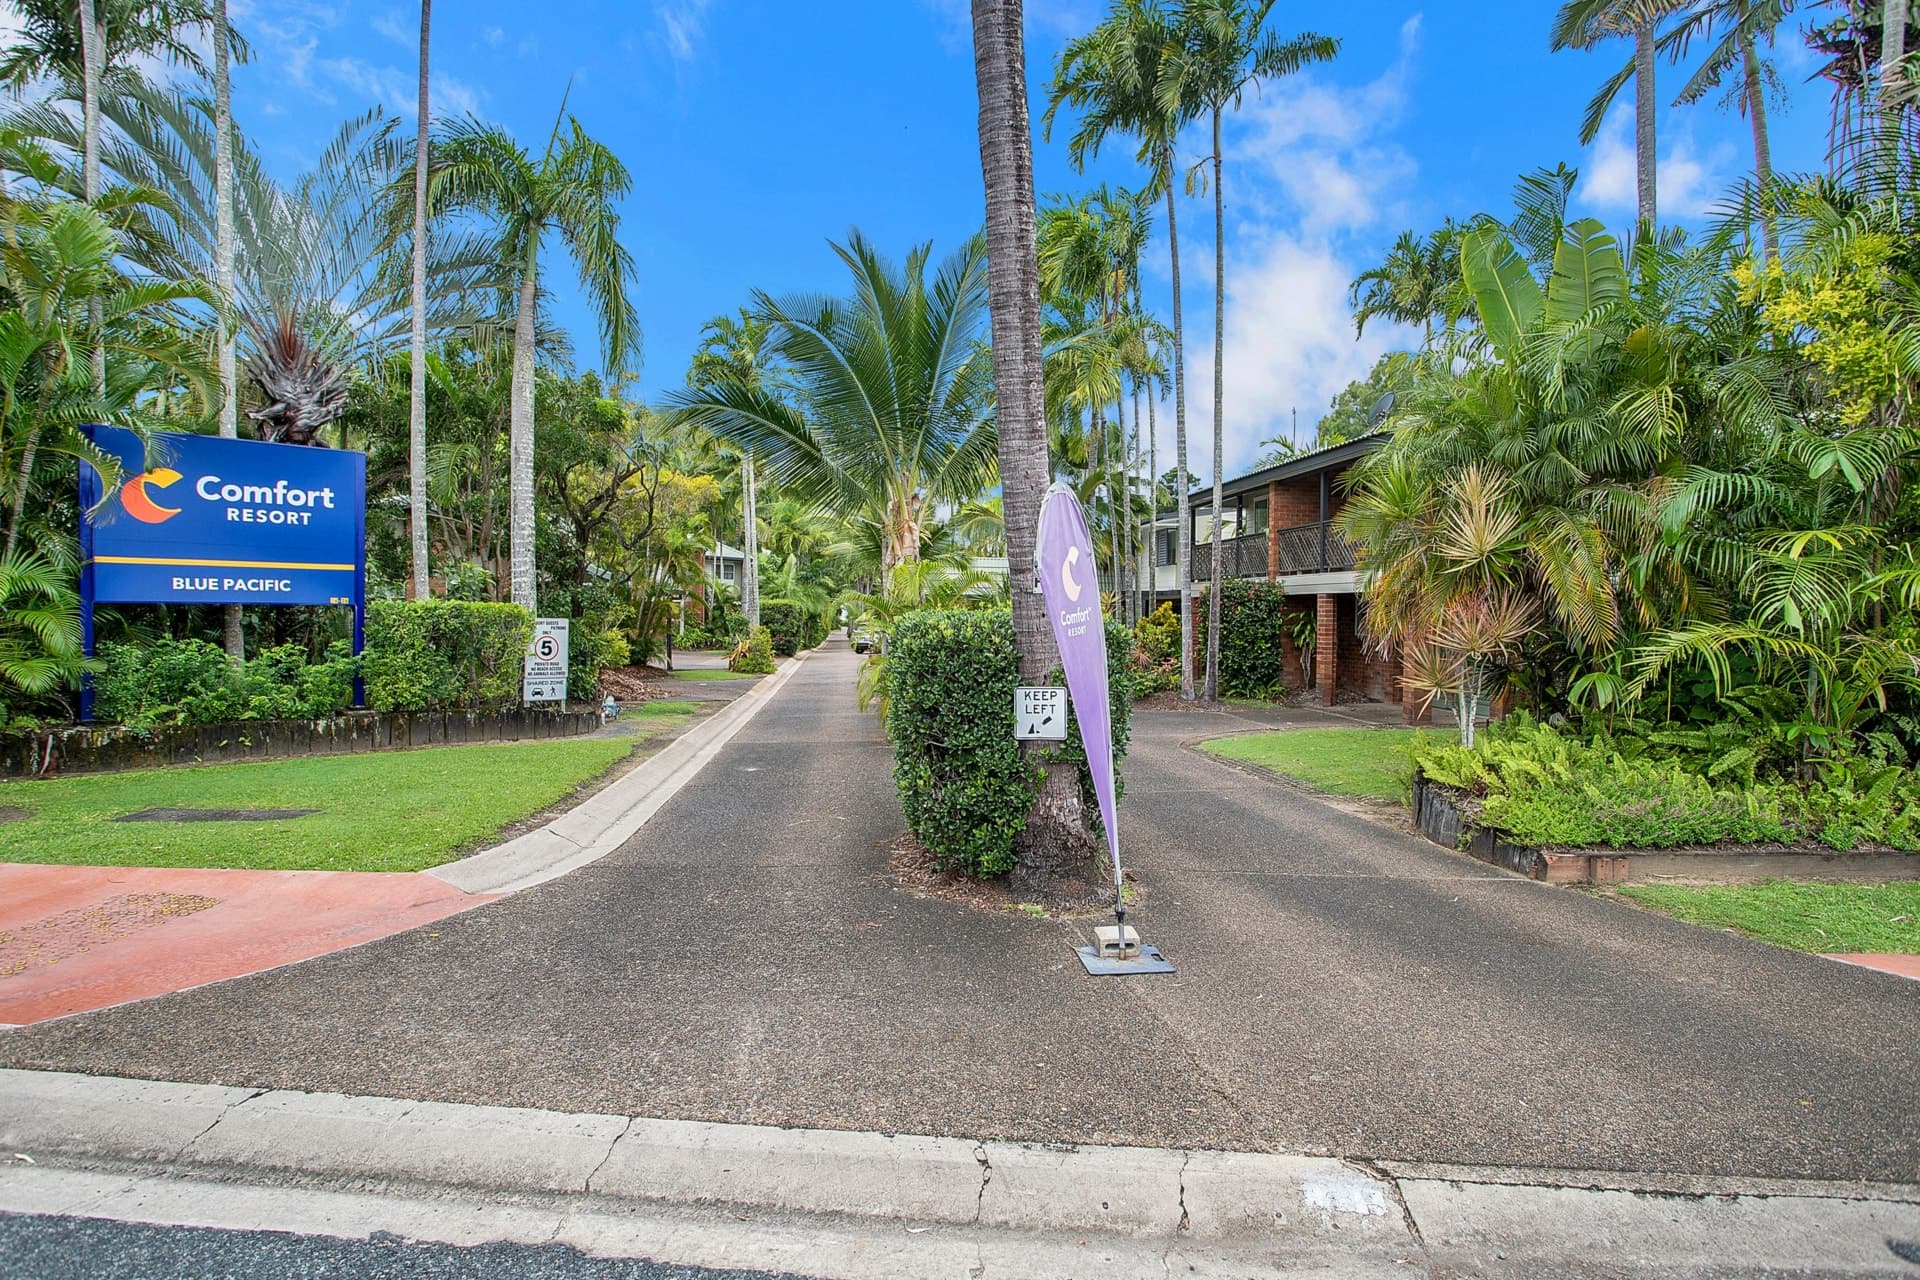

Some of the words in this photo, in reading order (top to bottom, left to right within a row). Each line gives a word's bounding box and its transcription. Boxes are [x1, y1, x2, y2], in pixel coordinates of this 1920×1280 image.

[196, 475, 335, 509] Comfort
[226, 507, 312, 526] RESORT
[172, 577, 220, 591] BLUE
[223, 578, 292, 592] PACIFIC
[1060, 607, 1090, 626] Comfort
[1067, 625, 1087, 637] RESORT
[540, 640, 553, 656] 5
[1024, 690, 1058, 701] KEEP
[1025, 703, 1057, 714] LEFT
